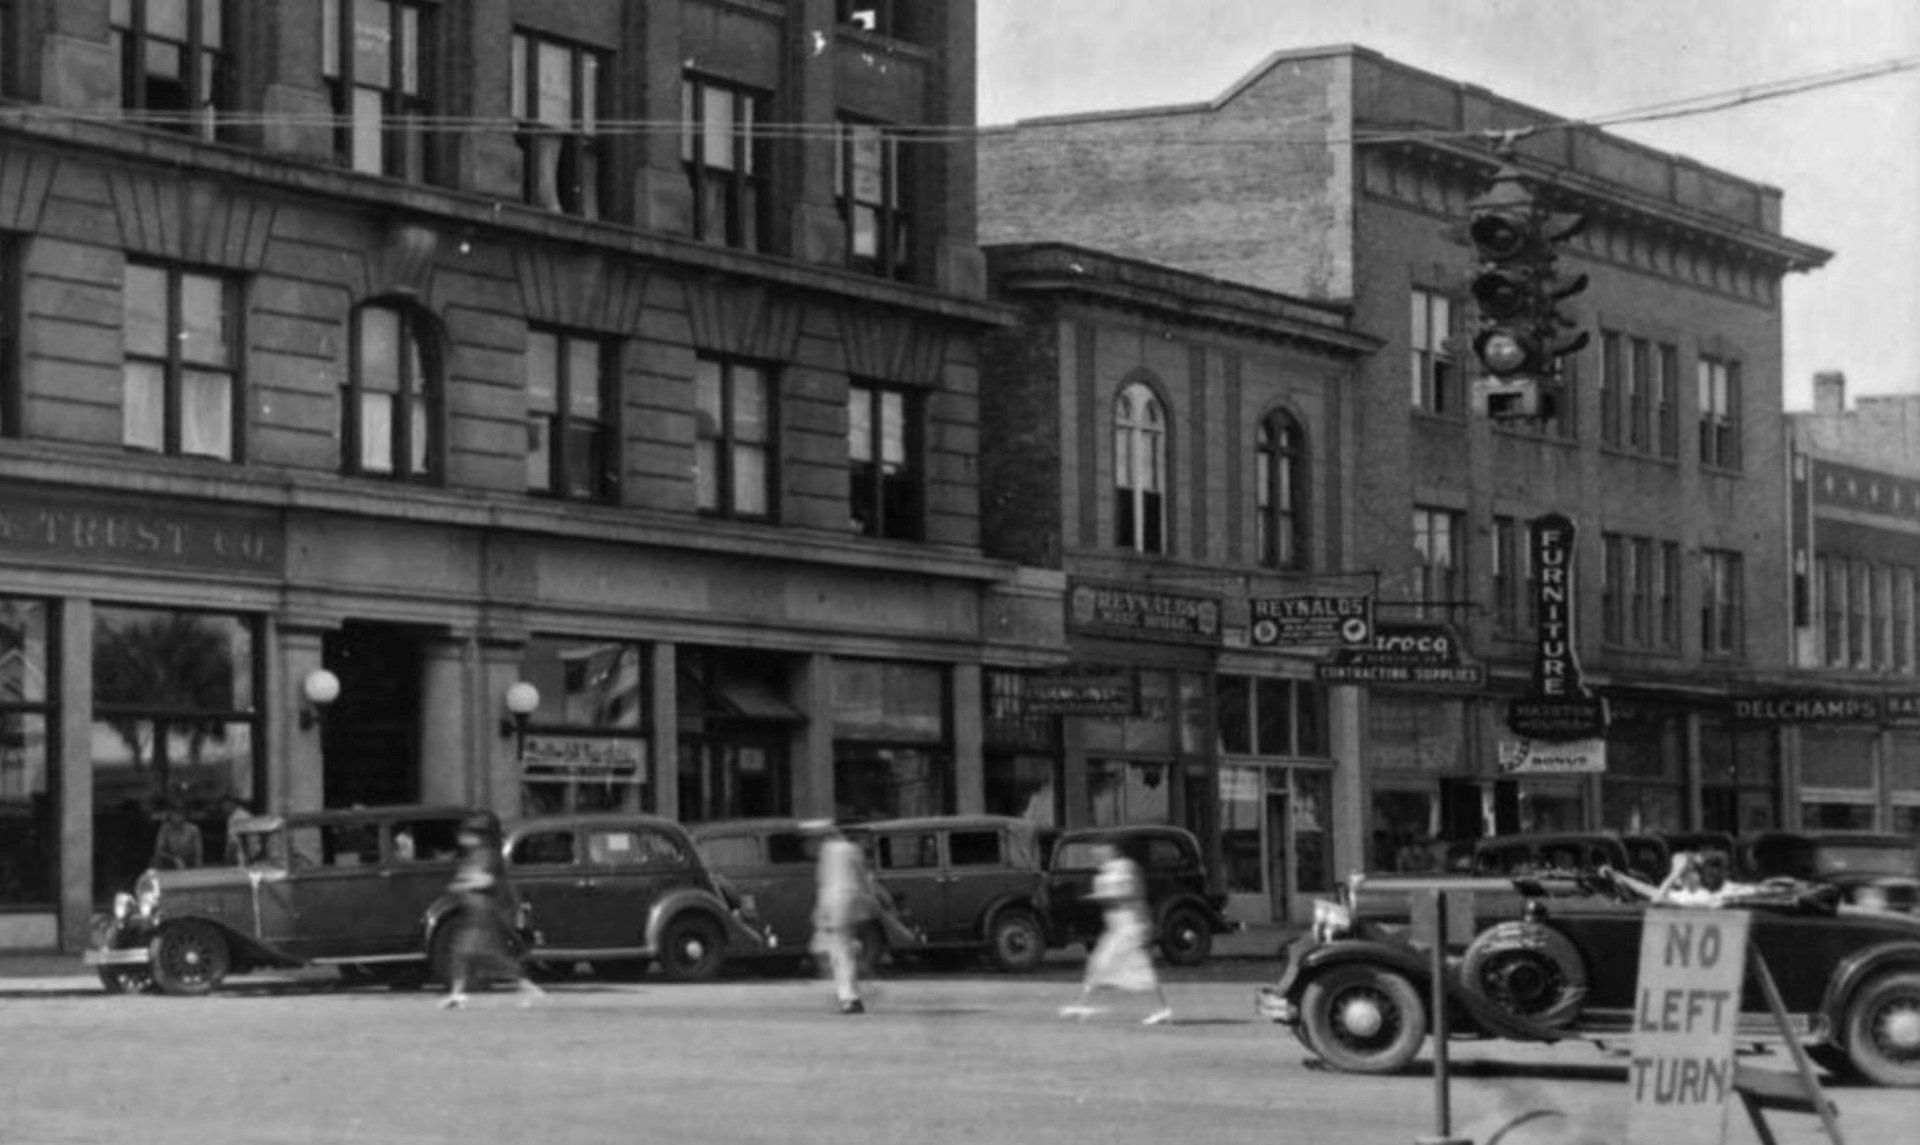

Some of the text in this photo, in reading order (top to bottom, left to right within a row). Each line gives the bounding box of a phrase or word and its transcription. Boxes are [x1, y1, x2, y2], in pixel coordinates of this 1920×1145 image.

[1542, 529, 1566, 695] FURNITURE
[1320, 666, 1478, 683] CONTRACTING SUPPLIES
[1736, 700, 1877, 719] DELCHAMPS
[1664, 921, 1723, 968] NO
[1639, 988, 1731, 1034] LEFT
[1633, 1057, 1729, 1105] TURN
